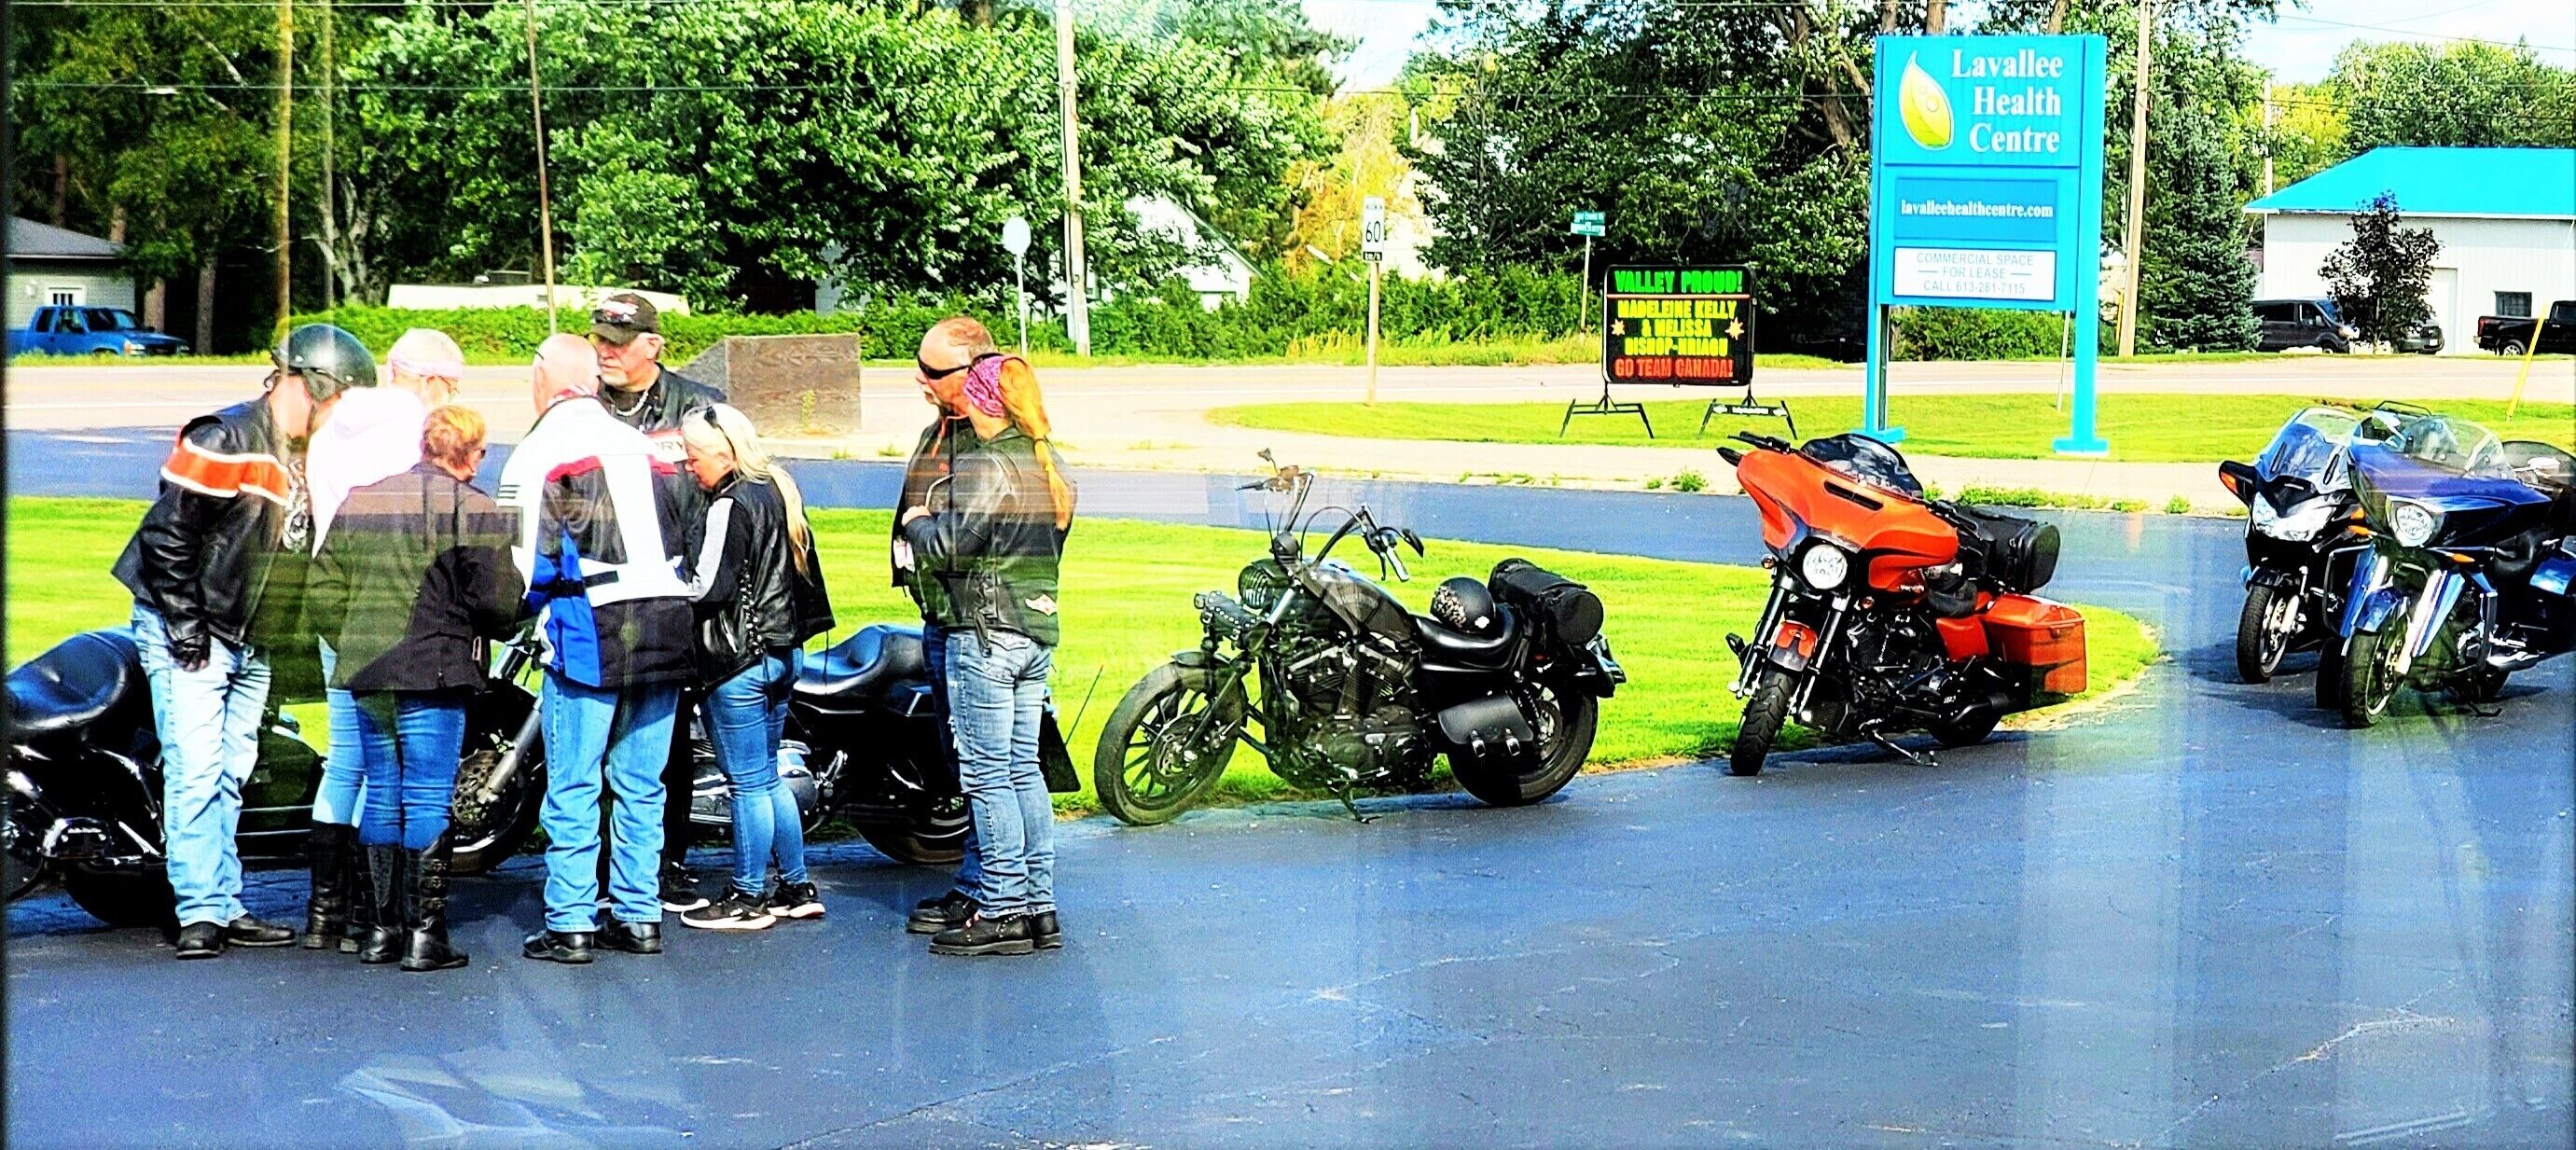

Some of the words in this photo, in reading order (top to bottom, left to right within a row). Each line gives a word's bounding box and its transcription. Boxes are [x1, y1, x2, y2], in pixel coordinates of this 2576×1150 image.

[1951, 48, 2064, 78] Lavallee
[1973, 85, 2062, 117] Health
[1969, 121, 2061, 153] Centre
[1901, 199, 2054, 218] lavalleehealthcentre.com
[1365, 220, 1380, 242] 60
[1917, 252, 1992, 265] COMMERCIAL
[1997, 254, 2034, 267] SPACE
[1614, 270, 1675, 293] VALLEY
[1681, 270, 1743, 294] PROUD!
[1943, 267, 1966, 278] FOR
[1970, 268, 2006, 279] LEASE
[1923, 281, 1953, 292] CALL
[1956, 282, 2026, 295] 613-281-7115
[1617, 299, 1692, 318] MADELEINE
[1695, 299, 1737, 319] KELLY
[1641, 318, 1653, 337] &
[1654, 318, 1712, 337] MELISSA
[1614, 358, 1634, 378] GO
[1636, 358, 1672, 378] TEAM
[1674, 358, 1734, 378] CANADA!
